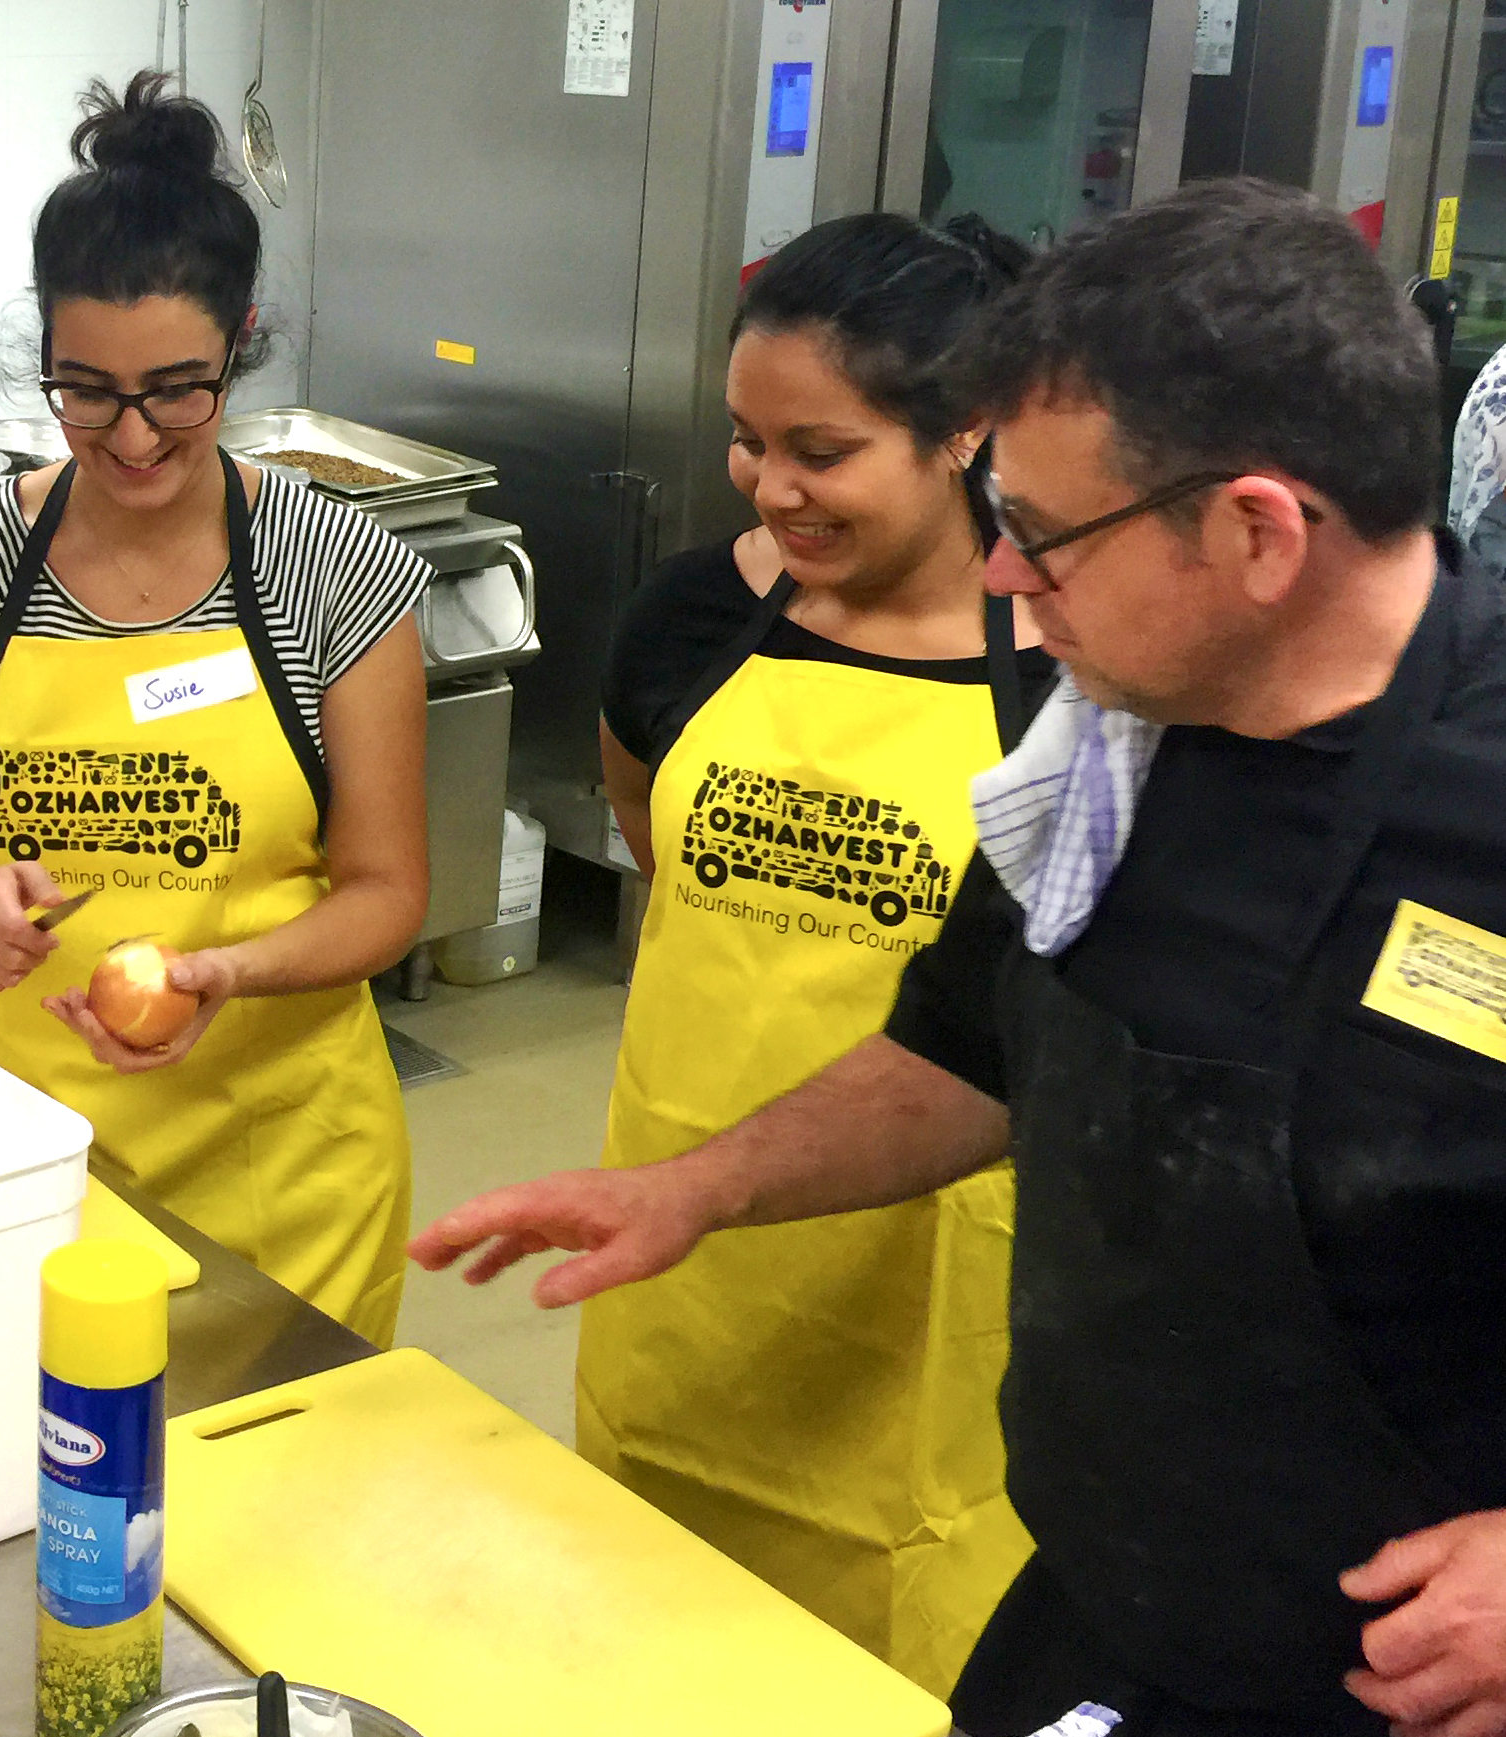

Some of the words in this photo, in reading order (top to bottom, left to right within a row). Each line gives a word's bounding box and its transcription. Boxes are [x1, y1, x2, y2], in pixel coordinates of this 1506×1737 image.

[143, 677, 205, 711] Susie
[10, 789, 200, 814] OZHARVEST
[708, 806, 909, 868] OZHARVEST
[49, 867, 105, 892] shing
[112, 868, 151, 889] Our
[675, 882, 790, 935] Nourishing
[797, 912, 842, 940] Our
[848, 923, 935, 956] Count
[38, 1507, 98, 1542] ANOLA
[48, 1535, 101, 1565] SPRAY
